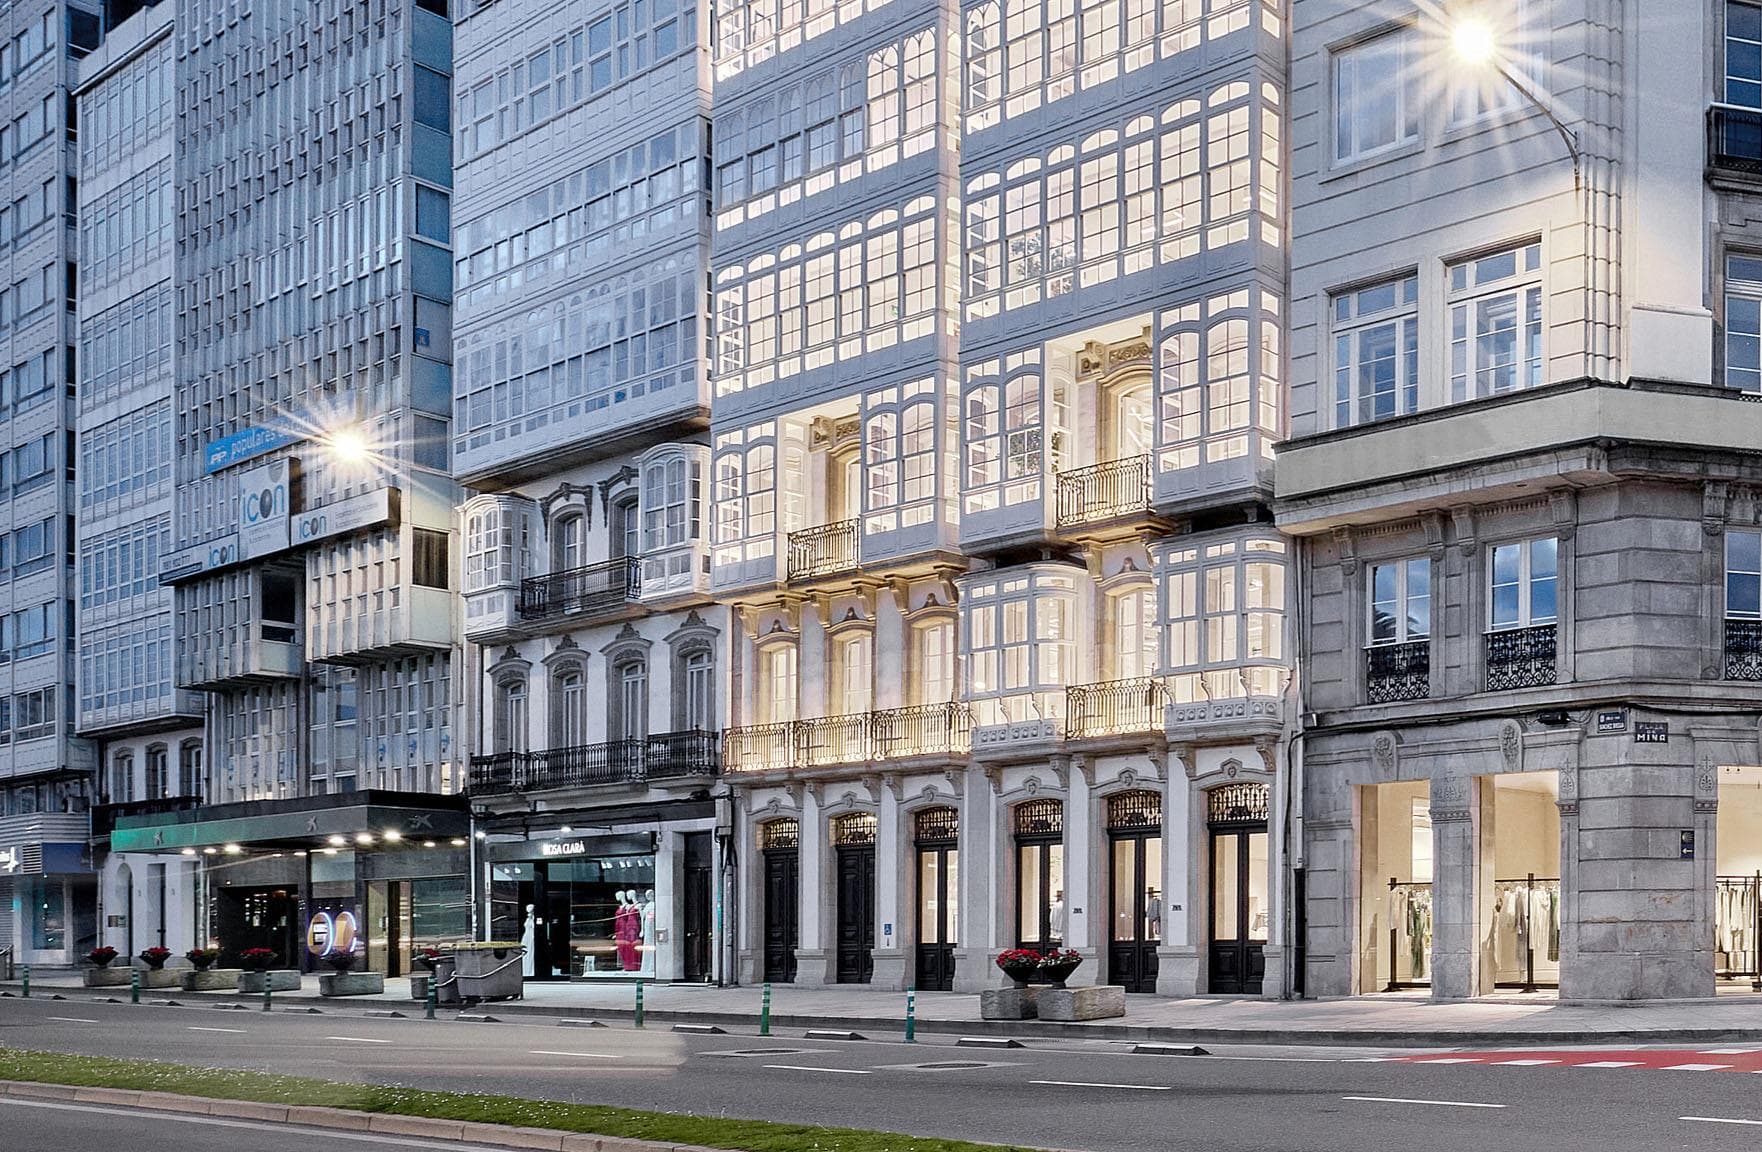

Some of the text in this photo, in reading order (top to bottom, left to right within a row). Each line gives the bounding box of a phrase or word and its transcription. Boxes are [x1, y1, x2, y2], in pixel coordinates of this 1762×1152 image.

[242, 484, 285, 525] icon
[298, 515, 327, 538] icon
[208, 544, 235, 568] icon
[1637, 734, 1666, 742] MINA
